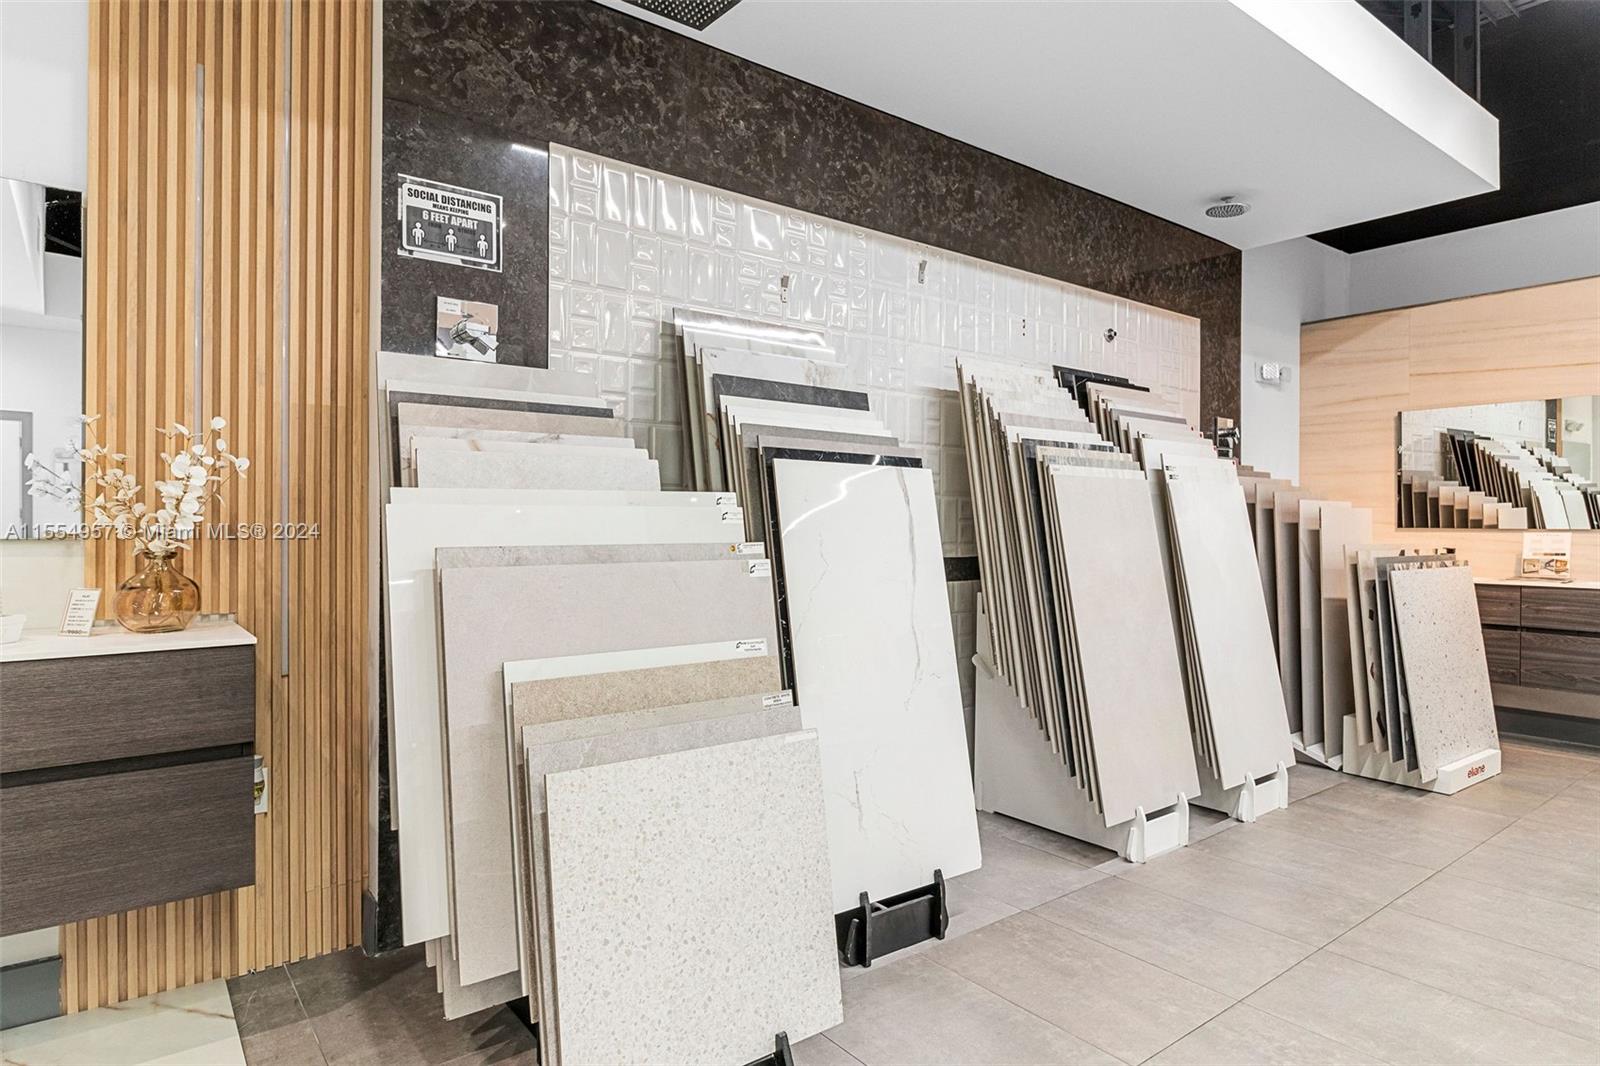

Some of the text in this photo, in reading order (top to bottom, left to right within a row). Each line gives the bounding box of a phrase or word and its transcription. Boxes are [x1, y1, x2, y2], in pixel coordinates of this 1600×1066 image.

[407, 187, 492, 214] SOCIAL DISTANCING
[432, 203, 469, 216] MEANS KEEPING
[422, 210, 479, 230] 6 FEET APART
